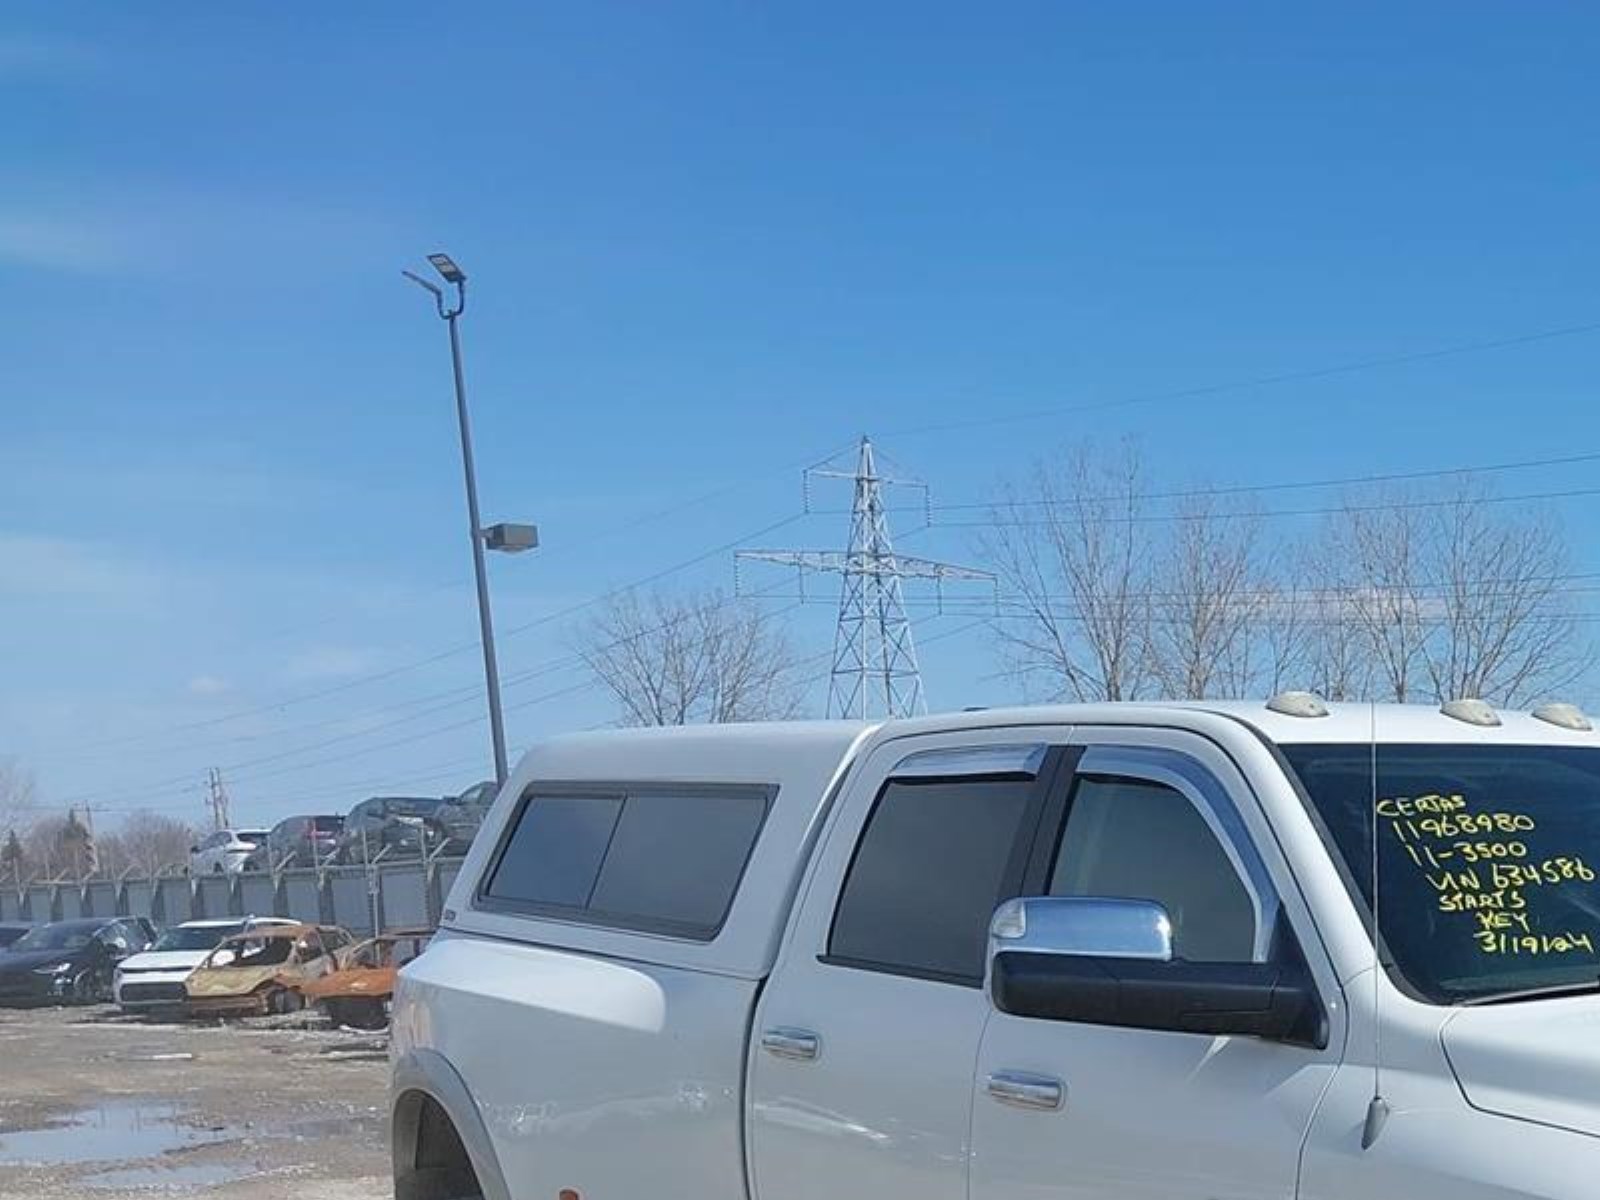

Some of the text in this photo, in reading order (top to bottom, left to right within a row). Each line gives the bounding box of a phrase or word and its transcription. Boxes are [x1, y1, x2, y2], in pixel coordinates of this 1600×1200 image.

[1392, 813, 1535, 843] 11968980
[1405, 841, 1527, 868] 11-3500
[1490, 857, 1595, 889] 634586
[1438, 891, 1526, 911] STARTS
[1475, 911, 1530, 934] KEY
